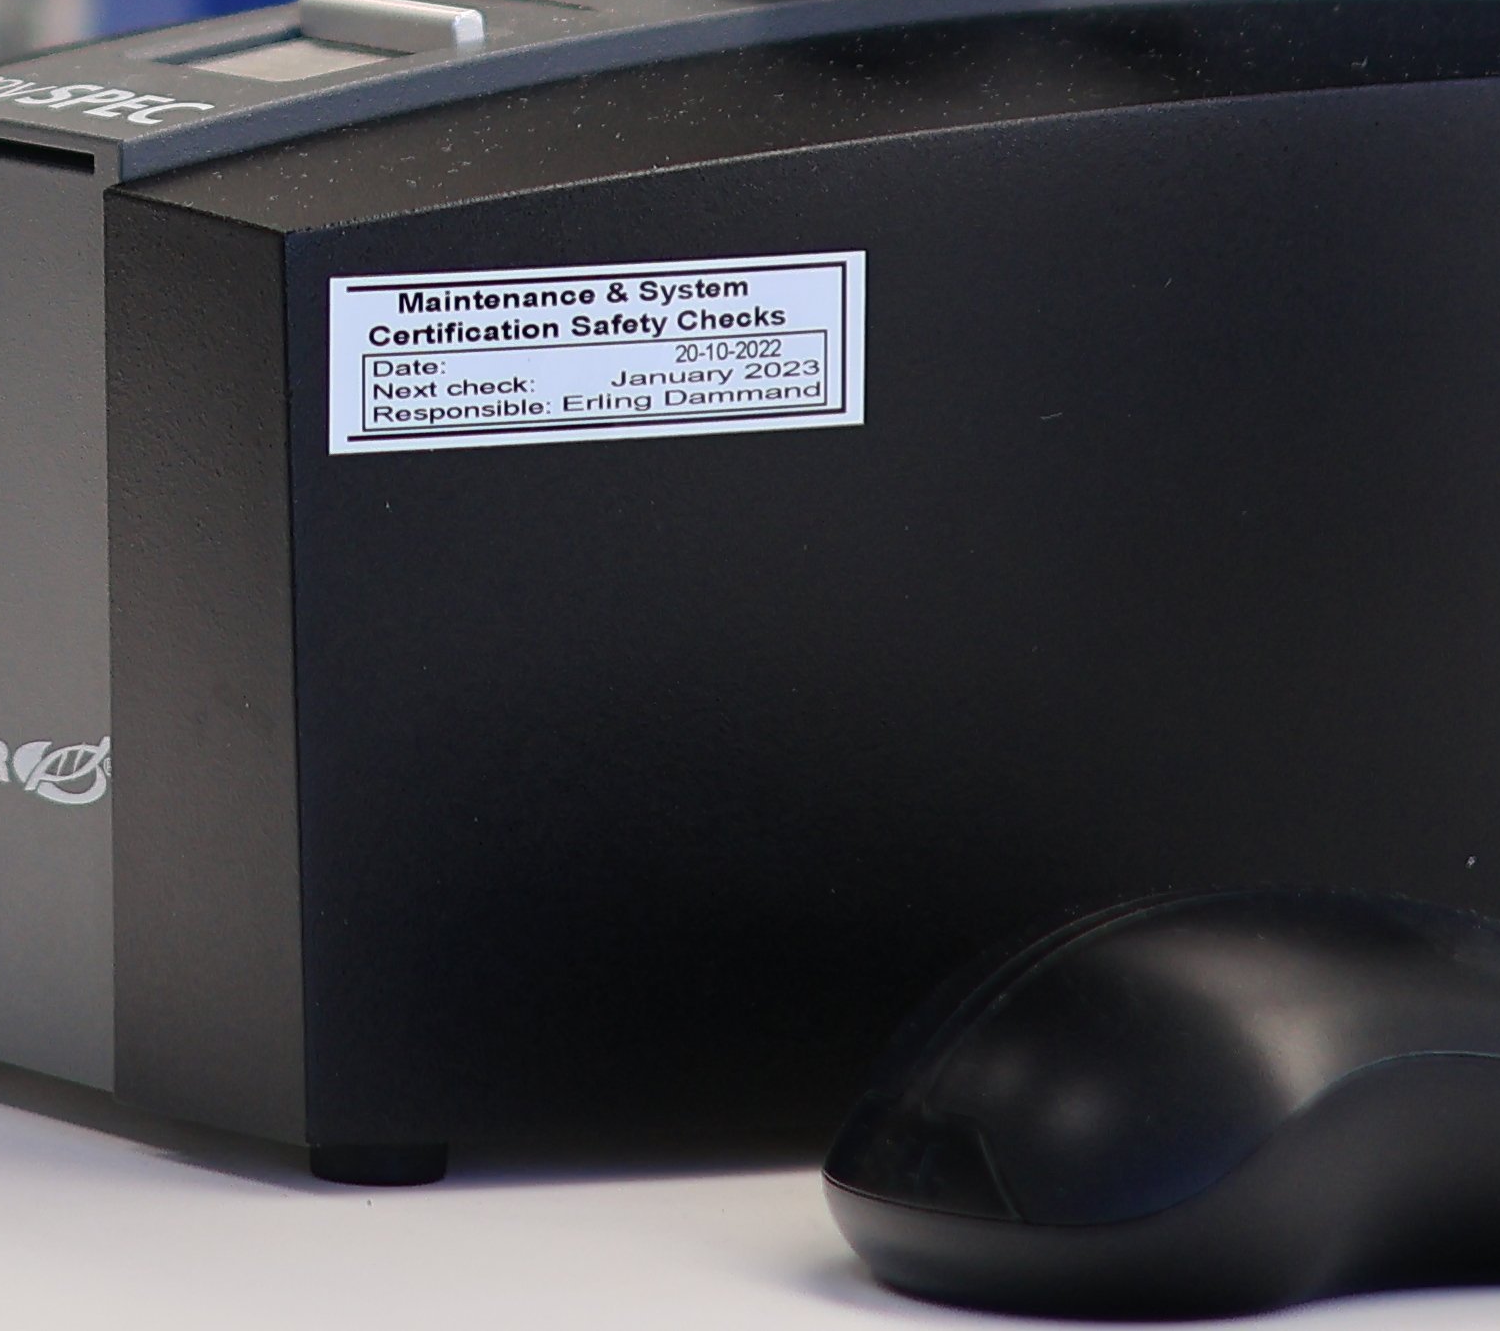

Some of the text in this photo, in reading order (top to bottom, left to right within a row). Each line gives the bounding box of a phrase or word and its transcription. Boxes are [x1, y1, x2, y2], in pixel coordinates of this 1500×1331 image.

[398, 279, 749, 314] Maintenance & System
[368, 305, 786, 346] Certification Safety Checks
[373, 338, 782, 378] Date: 20-10-2022
[373, 359, 820, 400] Next check: January 2023
[373, 380, 821, 424] Responsible: Erling Dammand
